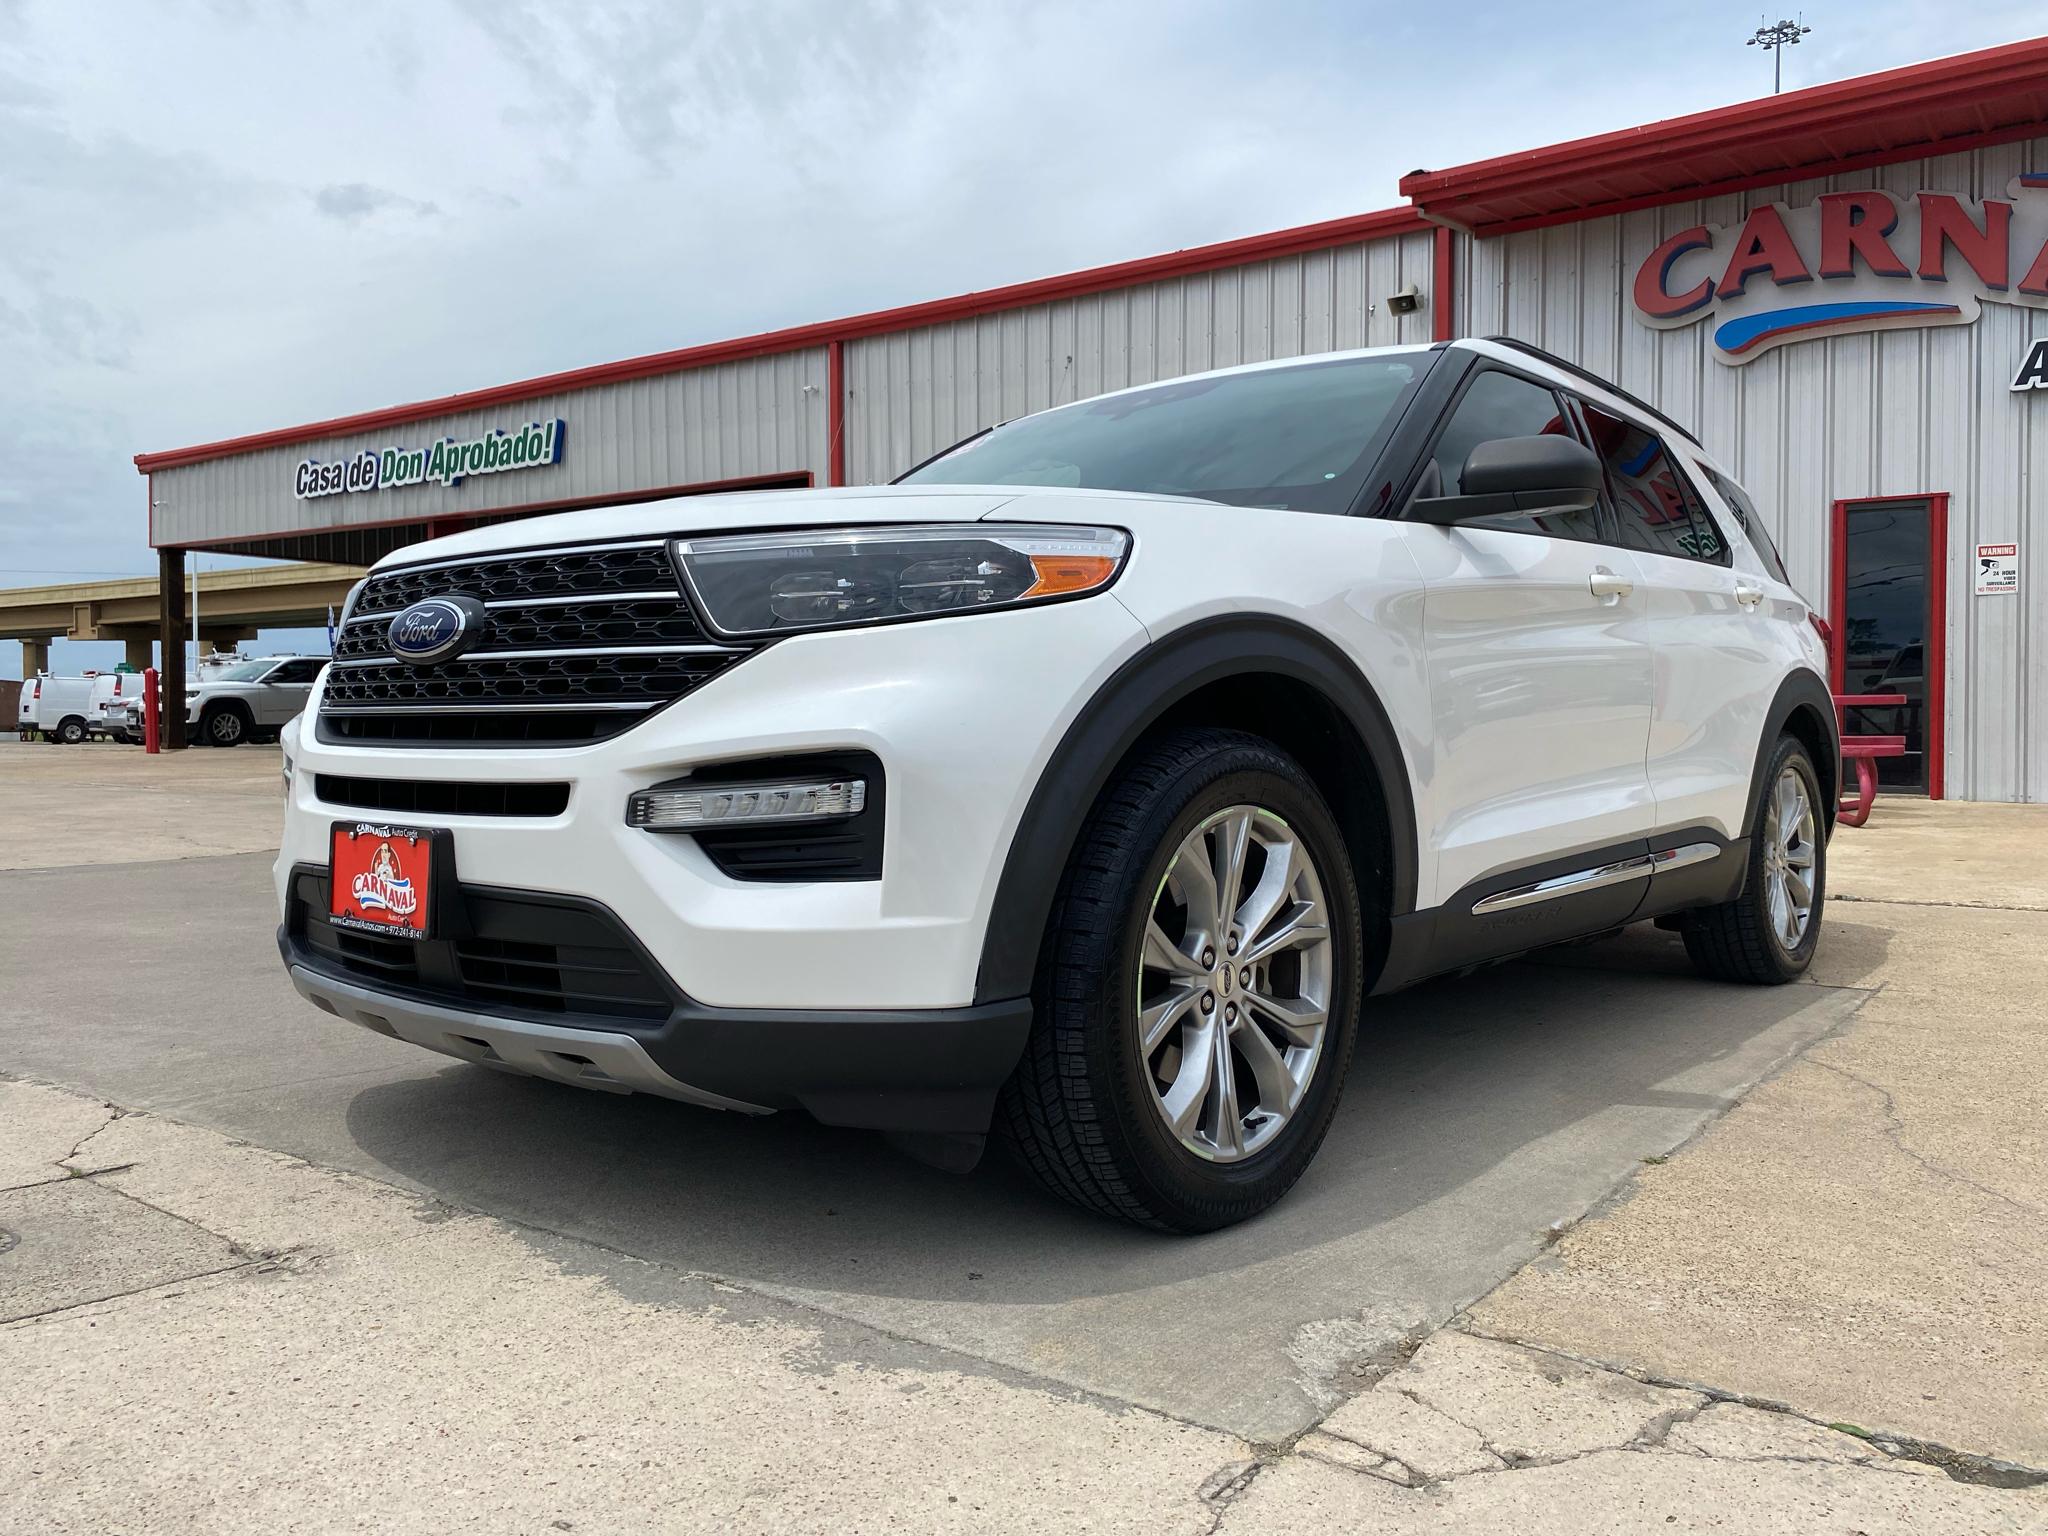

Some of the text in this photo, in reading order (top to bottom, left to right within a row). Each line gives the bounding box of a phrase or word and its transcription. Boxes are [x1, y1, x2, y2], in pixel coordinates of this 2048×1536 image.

[296, 422, 554, 495] Casa de Don Aprobado!
[1980, 547, 2014, 555] WARNING
[400, 611, 443, 643] Ford
[357, 823, 391, 838] CARNAVAL
[353, 874, 415, 909] CARNAVAL
